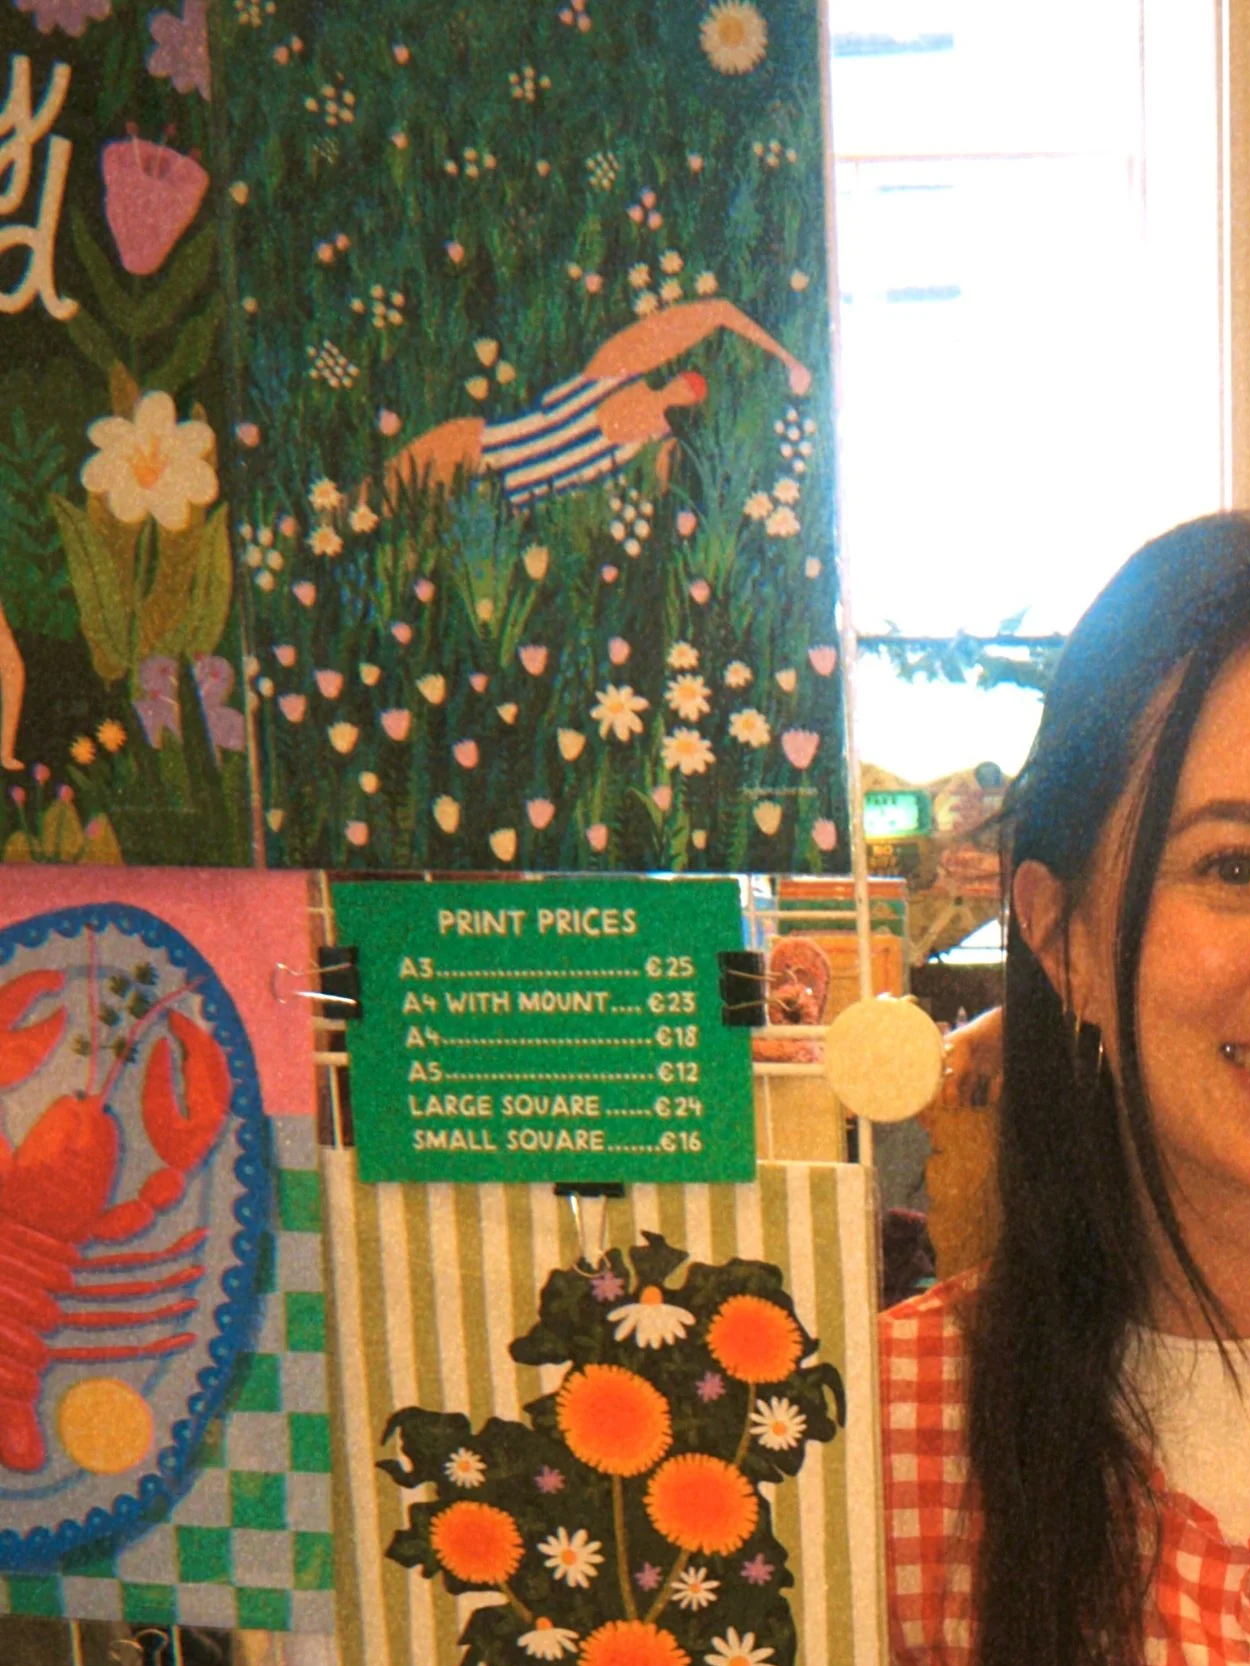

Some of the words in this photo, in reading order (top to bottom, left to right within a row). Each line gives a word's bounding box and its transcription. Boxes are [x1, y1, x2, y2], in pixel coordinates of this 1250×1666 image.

[439, 909, 526, 936] PRINT
[537, 908, 638, 936] PRICES
[644, 956, 694, 978] €25
[403, 991, 438, 1014] A4
[446, 991, 510, 1013] WITH
[647, 991, 696, 1013] €23
[655, 1025, 698, 1047] €18
[657, 1062, 698, 1082] €12
[409, 1095, 493, 1117] LARGE
[502, 1094, 600, 1117] SQUARE
[413, 1129, 498, 1151] SMALL
[507, 1129, 604, 1151] SQUARE
